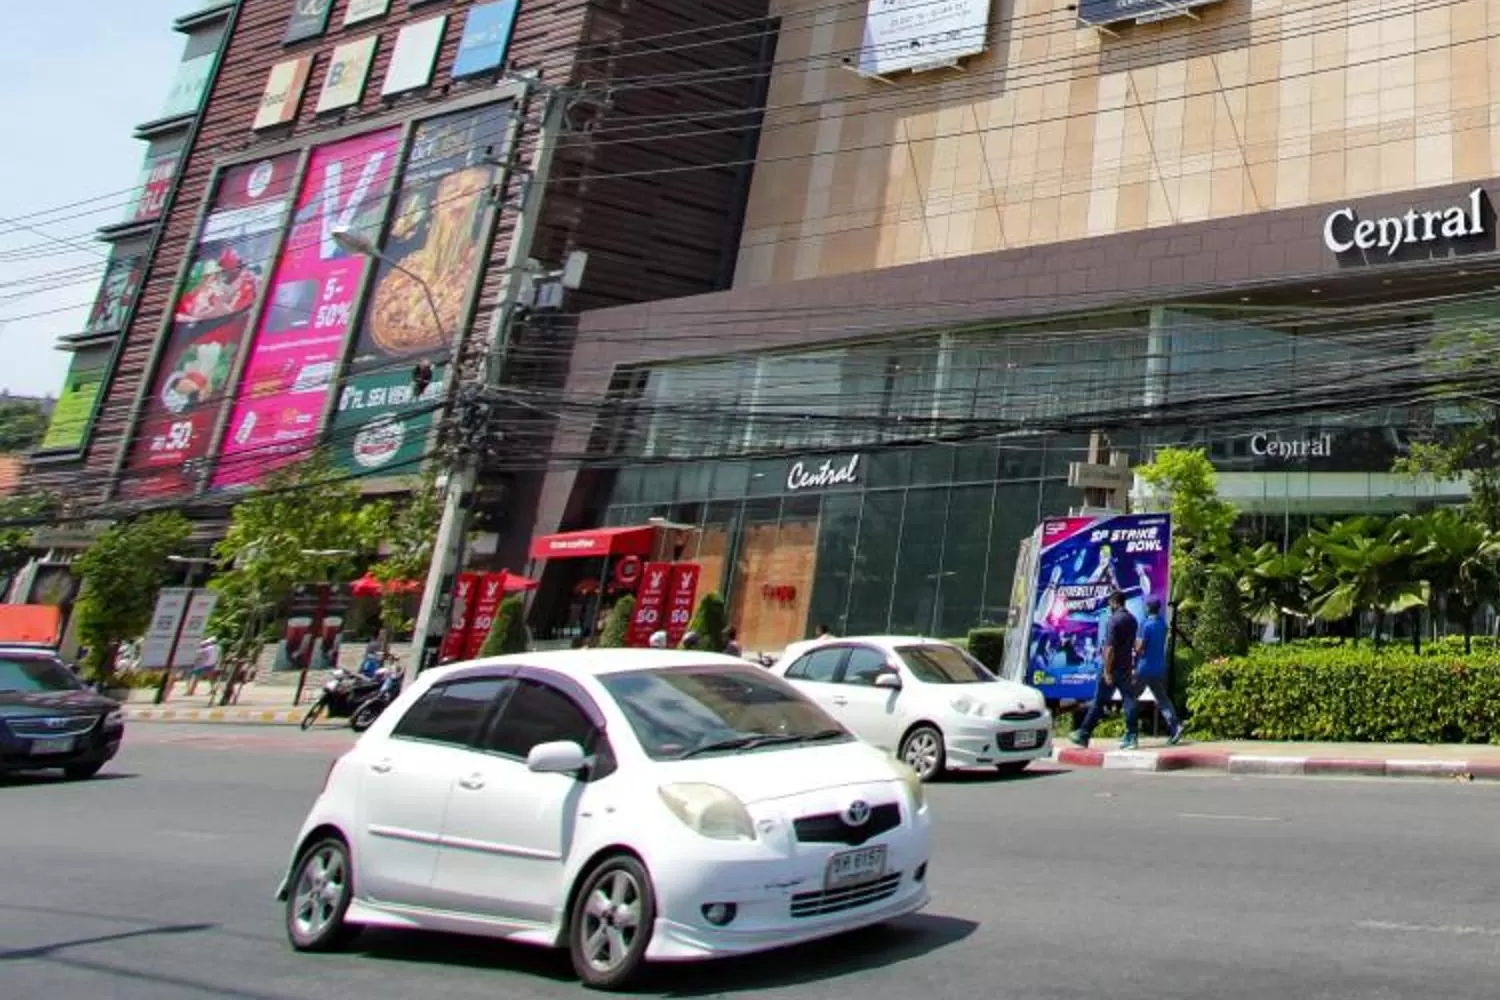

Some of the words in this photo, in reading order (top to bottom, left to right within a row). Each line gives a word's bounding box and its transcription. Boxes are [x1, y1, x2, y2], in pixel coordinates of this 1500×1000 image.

[1322, 186, 1485, 256] Central
[1250, 432, 1332, 460] Central
[787, 453, 861, 489] Central
[1109, 526, 1159, 542] STRIKE
[1125, 538, 1163, 553] BOWL
